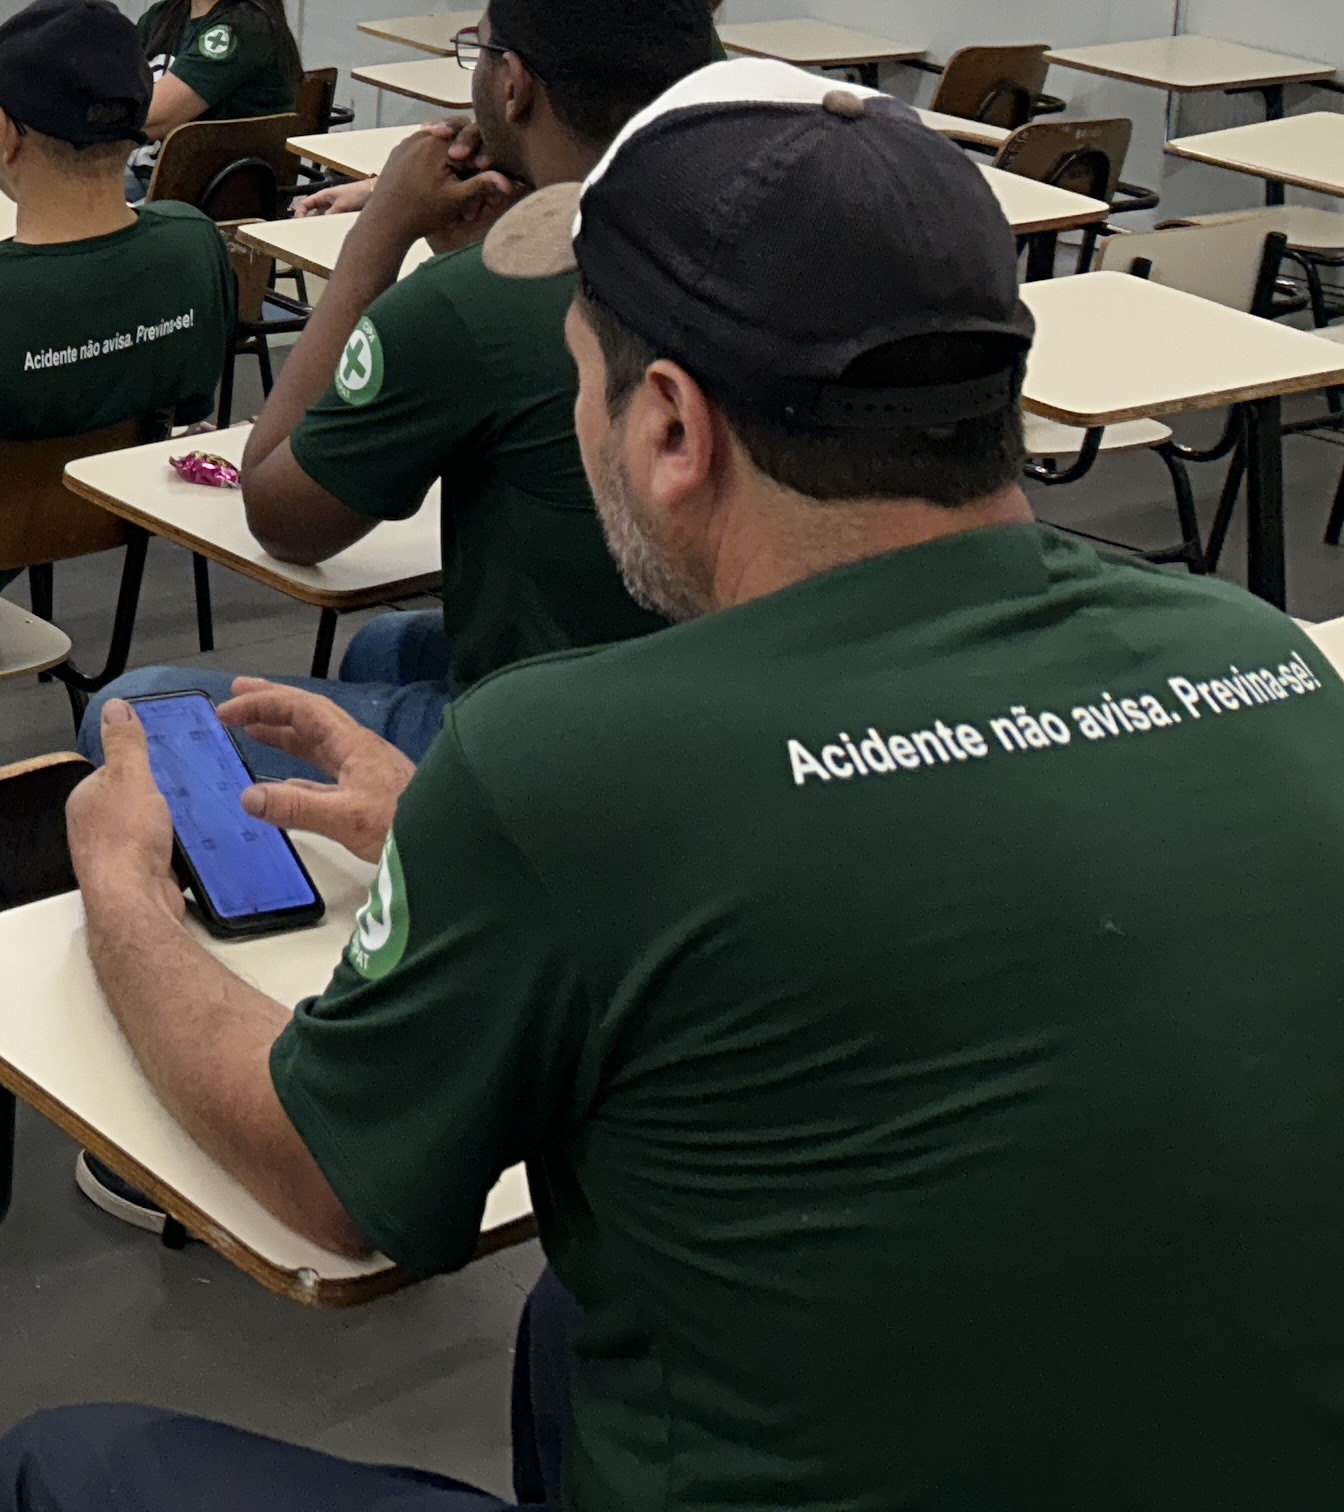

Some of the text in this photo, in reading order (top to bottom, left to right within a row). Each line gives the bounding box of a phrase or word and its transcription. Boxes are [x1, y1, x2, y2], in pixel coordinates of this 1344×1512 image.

[24, 308, 195, 371] Acidente não avisa. Previna-se!
[786, 649, 1323, 786] Acidente não avisa. Previna-se!
